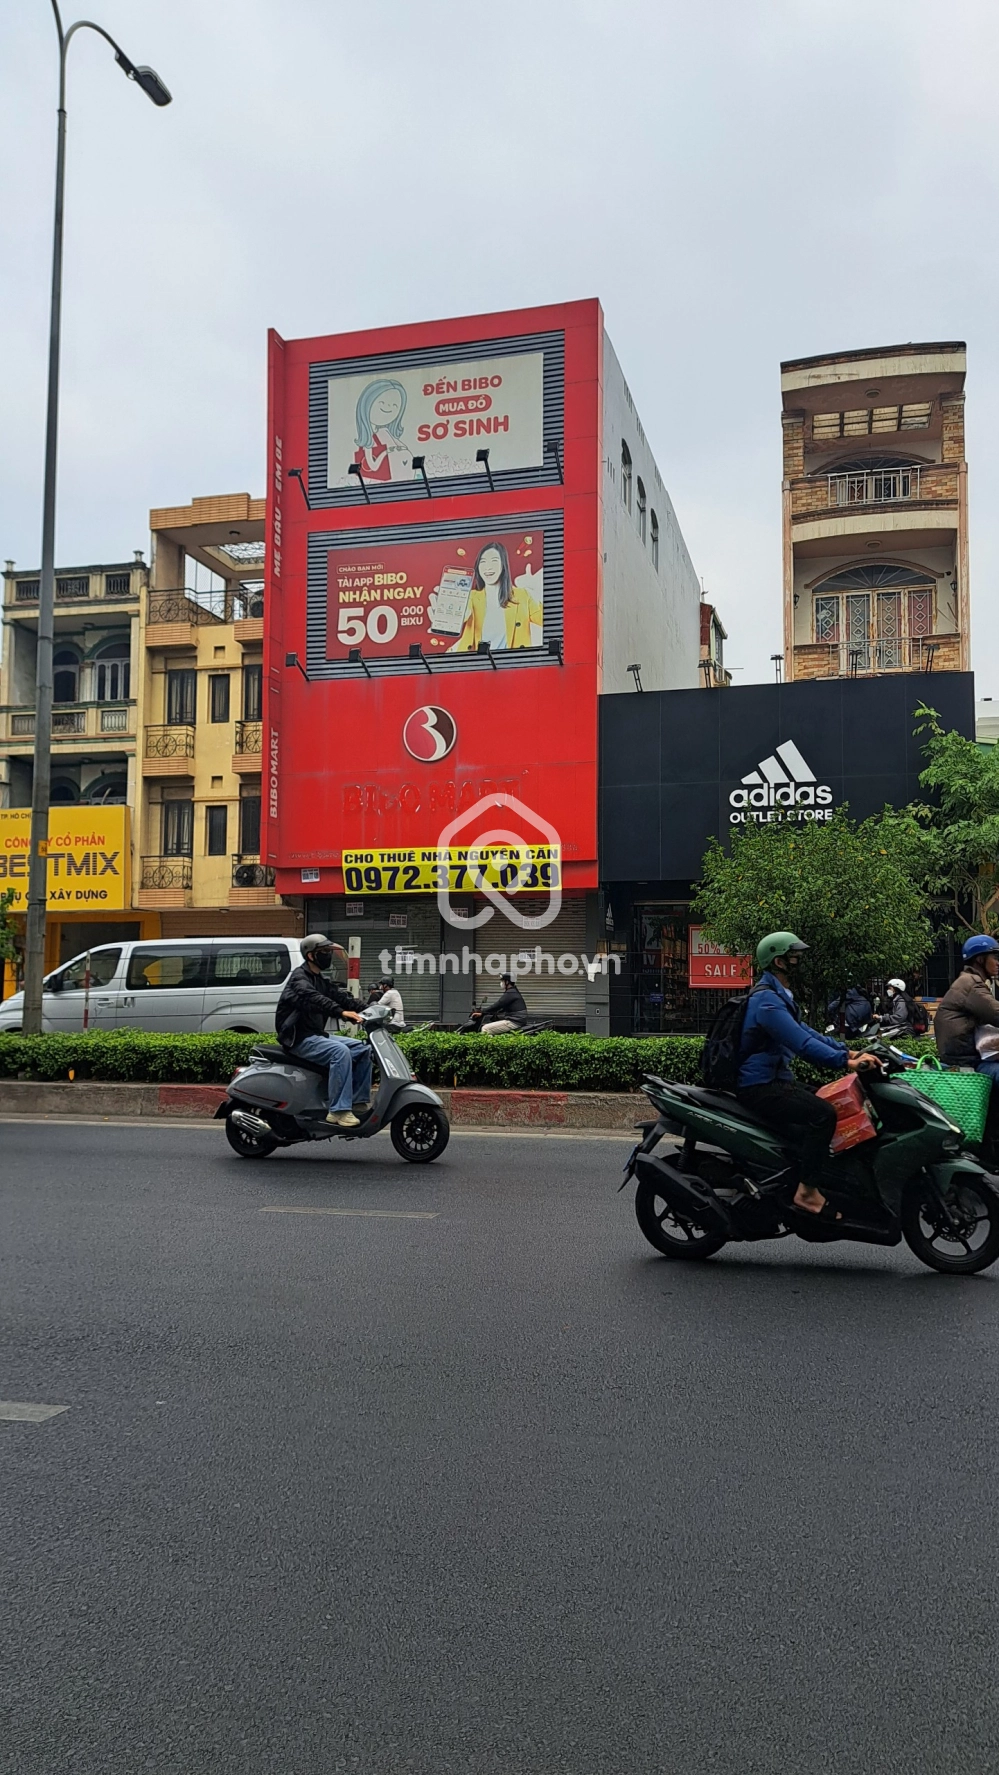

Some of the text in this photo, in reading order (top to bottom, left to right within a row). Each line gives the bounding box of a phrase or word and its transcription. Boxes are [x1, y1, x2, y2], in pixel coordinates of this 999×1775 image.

[422, 374, 503, 396] ĐẾN BIBO
[439, 395, 487, 413] MUA ĐỒ
[417, 414, 510, 442] SƠ SINH
[353, 577, 374, 587] APP
[374, 571, 407, 586] BIBO
[338, 586, 424, 605] NHẬN NGAY
[337, 605, 399, 645] 50
[400, 617, 424, 626] BIXU
[269, 727, 280, 818] BIBO MART
[729, 781, 833, 808] adidas
[786, 808, 834, 822] STORE
[344, 853, 374, 864] CHO
[379, 850, 416, 863] THUÊ
[420, 848, 453, 862] NHÀ
[457, 847, 520, 861] NGUYÊN
[528, 846, 559, 860] CĂN
[0, 851, 120, 878] ETMIX
[344, 861, 560, 892] 0972.377.039
[0, 892, 21, 903] PỤ
[49, 888, 72, 900] XÂY
[75, 889, 108, 902] DỰNG
[697, 943, 721, 955] 50%
[704, 963, 738, 978] SALE
